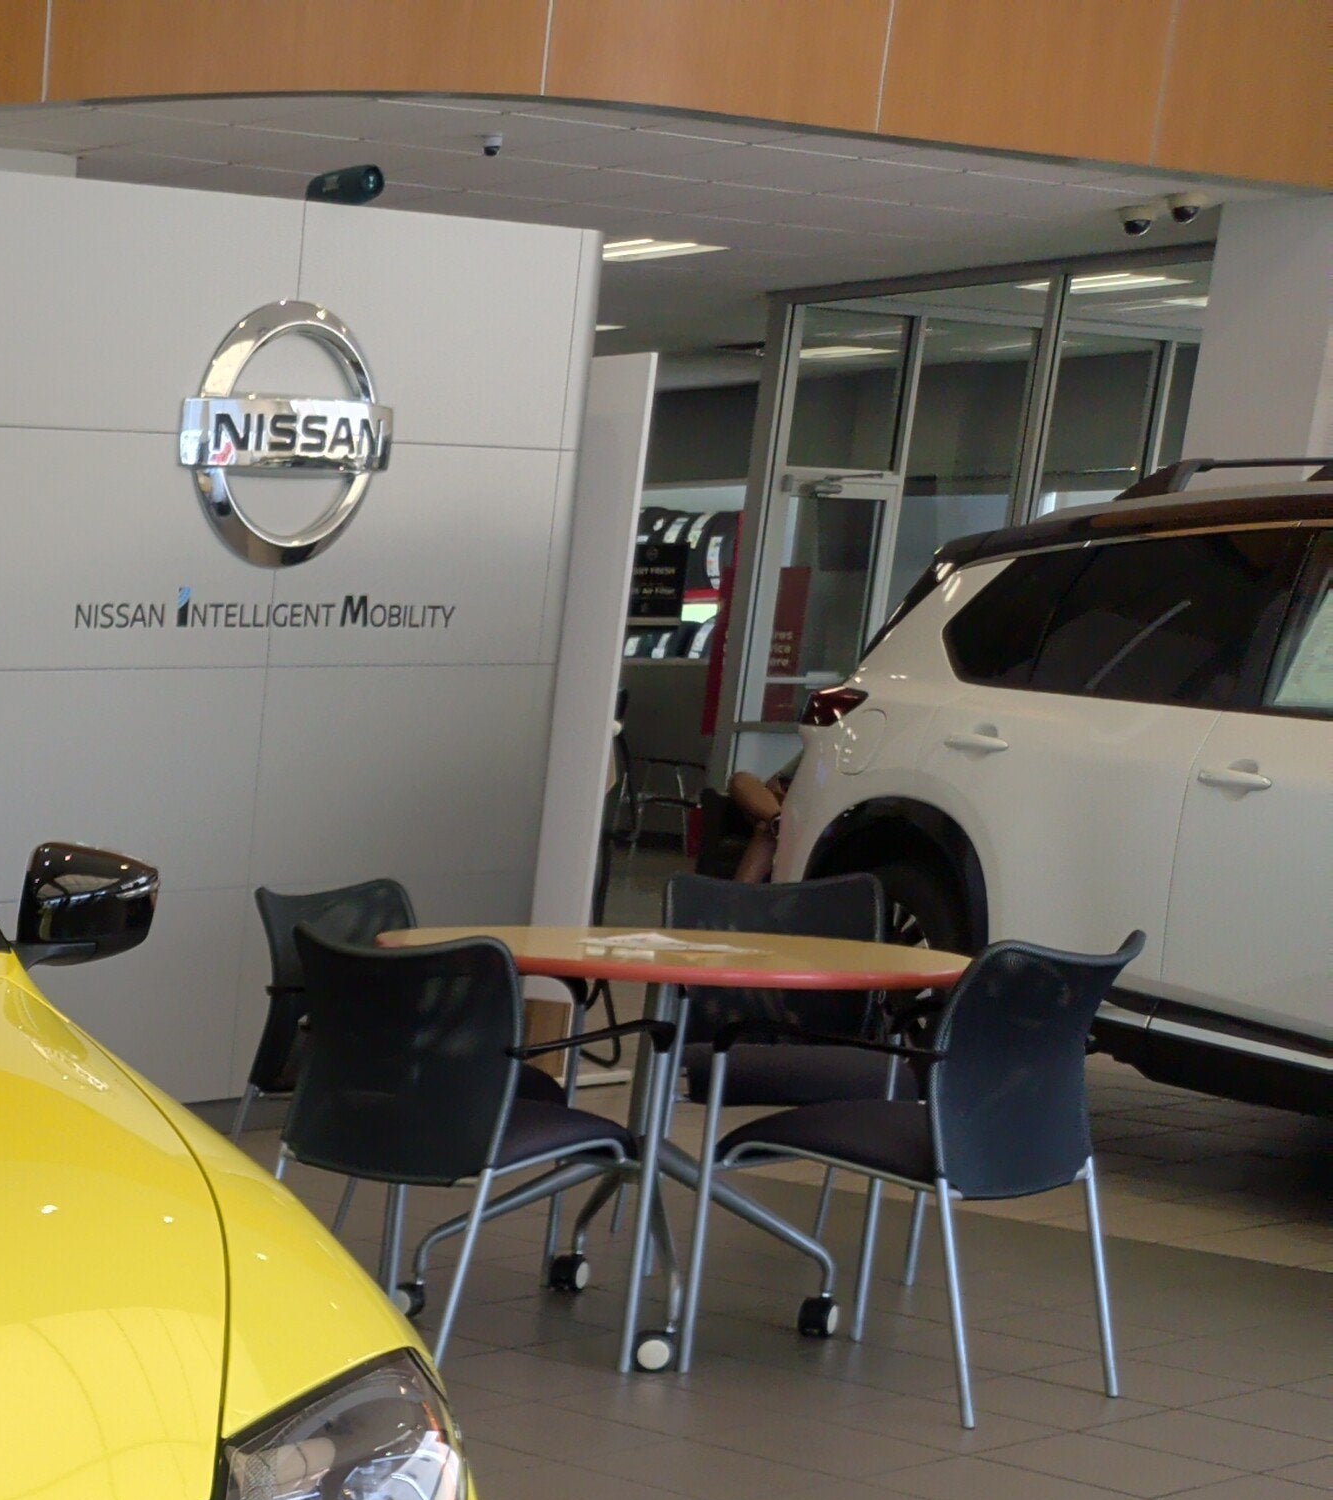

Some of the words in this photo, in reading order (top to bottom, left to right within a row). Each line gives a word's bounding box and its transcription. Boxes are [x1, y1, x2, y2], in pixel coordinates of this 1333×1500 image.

[211, 412, 386, 460] NISSAN
[73, 602, 167, 630] NISSAN
[176, 585, 337, 630] INTELLIGENT
[339, 595, 457, 630] MOBILITY
